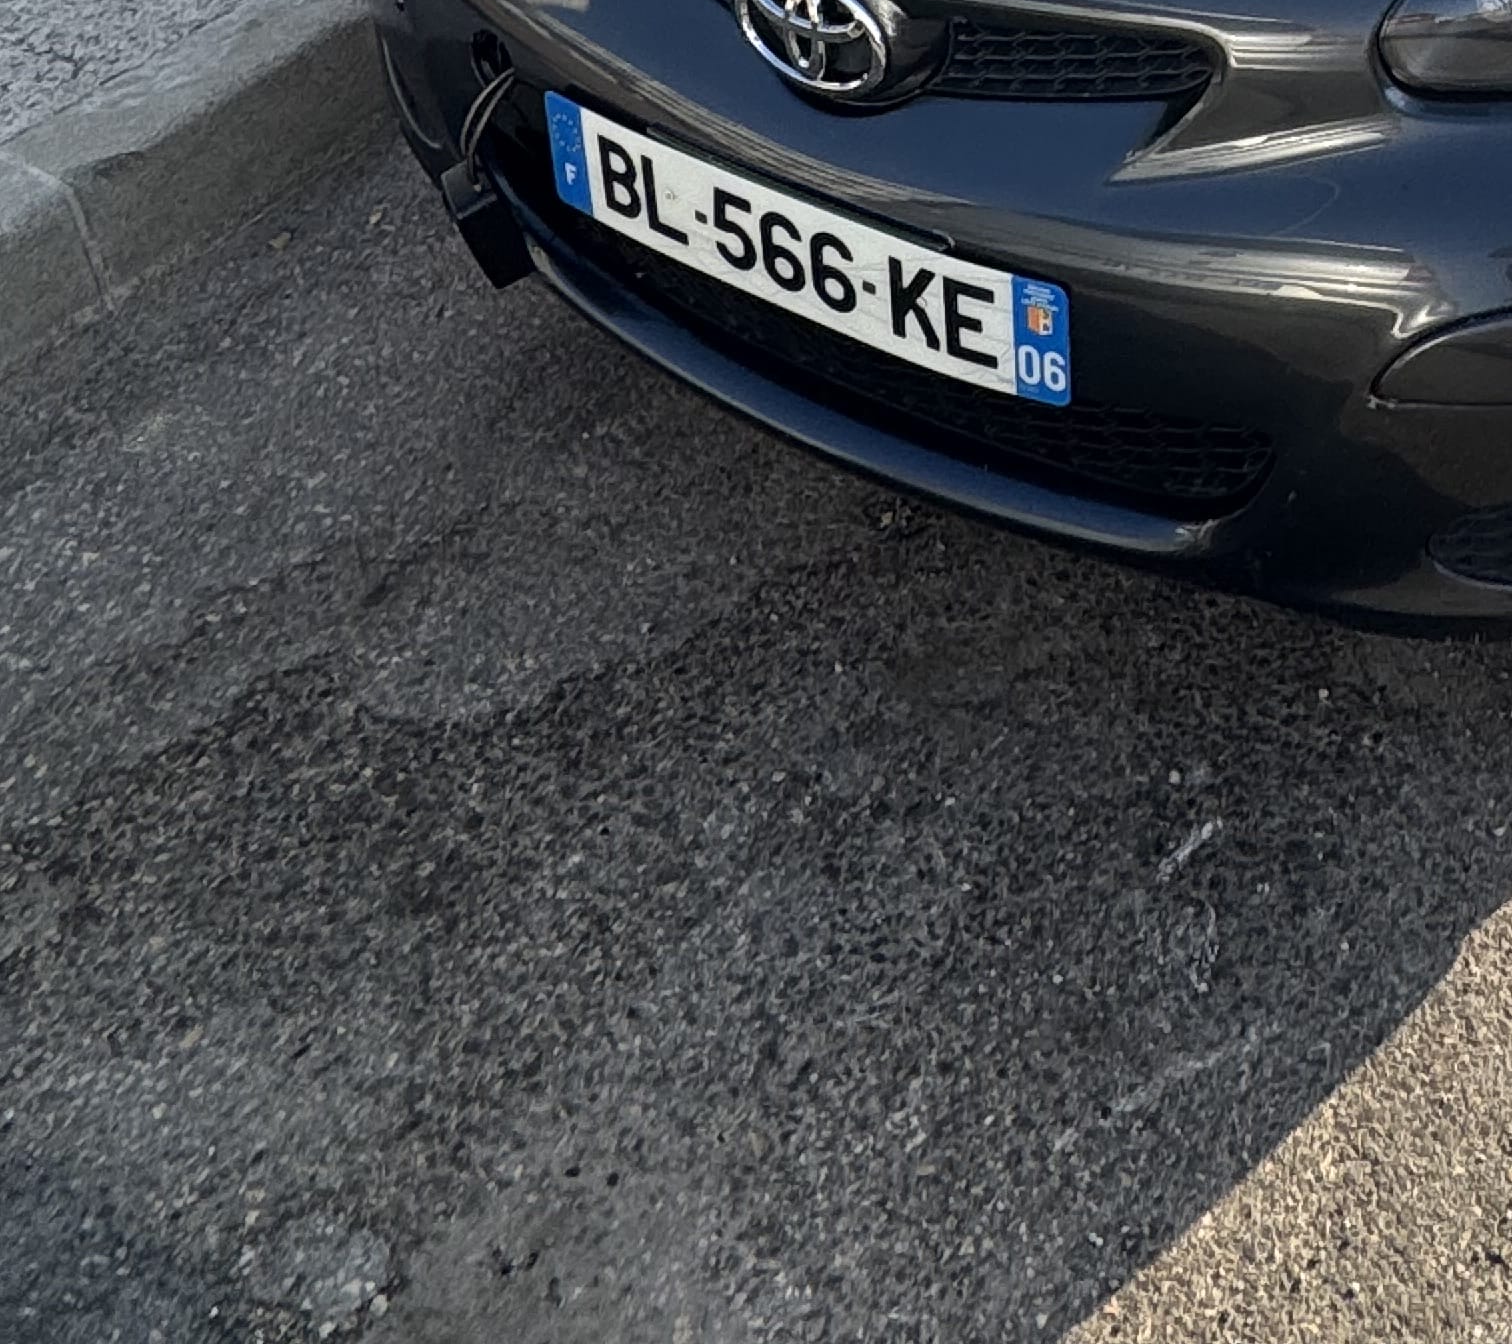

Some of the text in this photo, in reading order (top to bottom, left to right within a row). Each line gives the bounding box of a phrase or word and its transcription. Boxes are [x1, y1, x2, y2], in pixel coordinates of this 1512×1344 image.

[564, 162, 577, 186] F
[597, 133, 999, 370] BL-566-KE
[1018, 345, 1067, 392] 06
